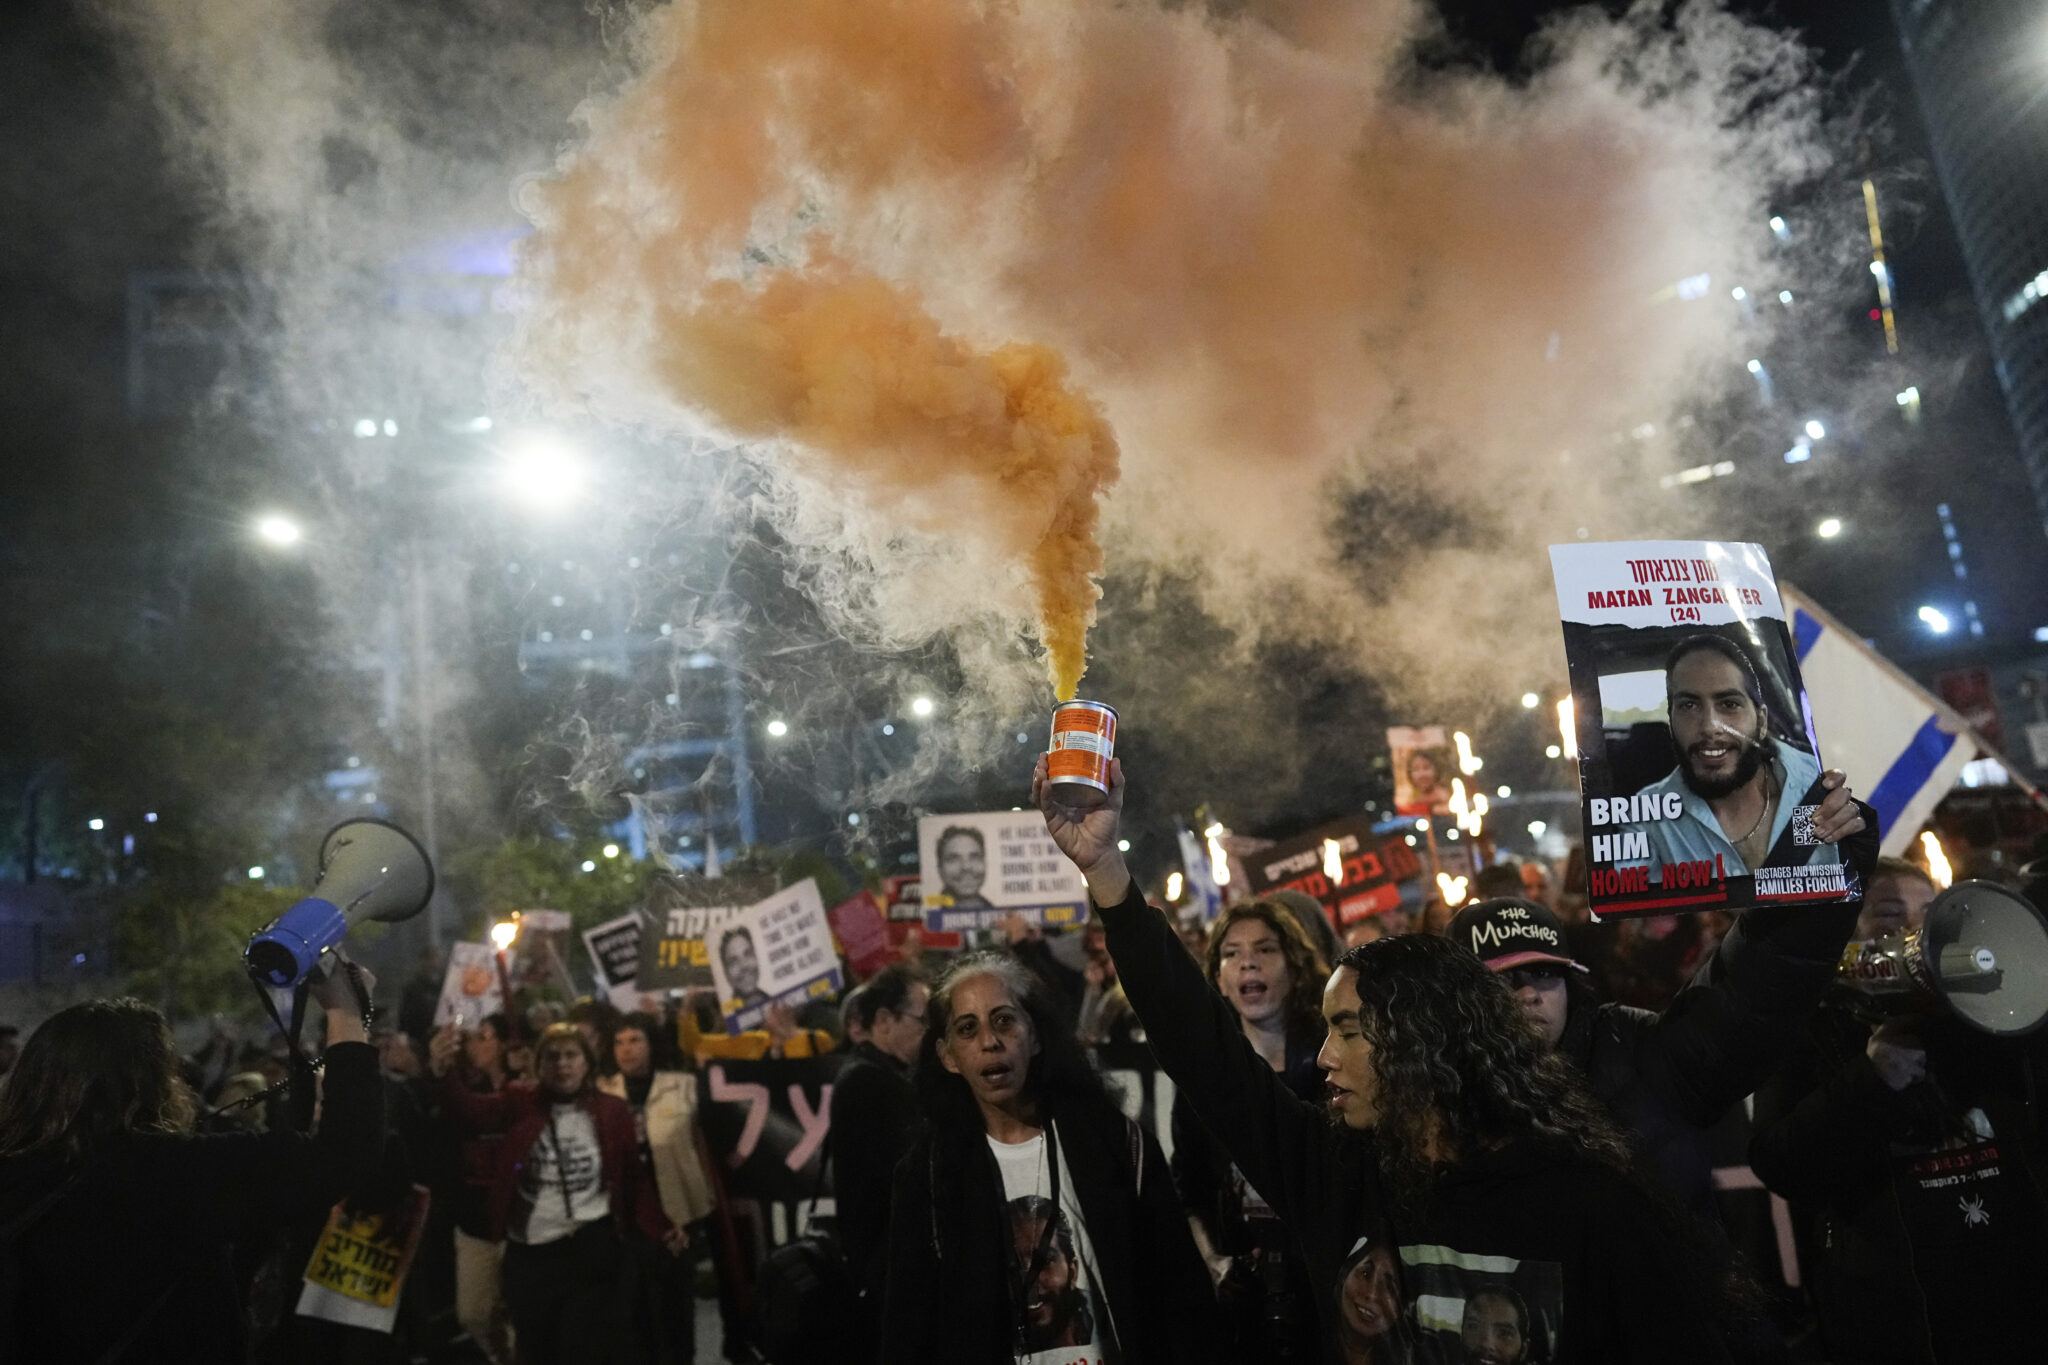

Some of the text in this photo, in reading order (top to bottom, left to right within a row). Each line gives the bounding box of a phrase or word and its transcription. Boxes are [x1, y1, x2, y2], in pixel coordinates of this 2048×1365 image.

[1626, 559, 1690, 585] צנגאוקר
[1587, 587, 1762, 609] MATAN ZANGAER
[1670, 607, 1701, 622] (24)
[1590, 792, 1683, 826] BRING
[1592, 831, 1650, 863] HIM
[1591, 853, 1726, 897] HOME NOW!
[1754, 863, 1844, 880] HOSTAGES AND MISSING
[1755, 875, 1846, 896] FAMILIES FORUM
[326, 1233, 398, 1274] מחריב
[318, 1253, 392, 1296] ישראל
